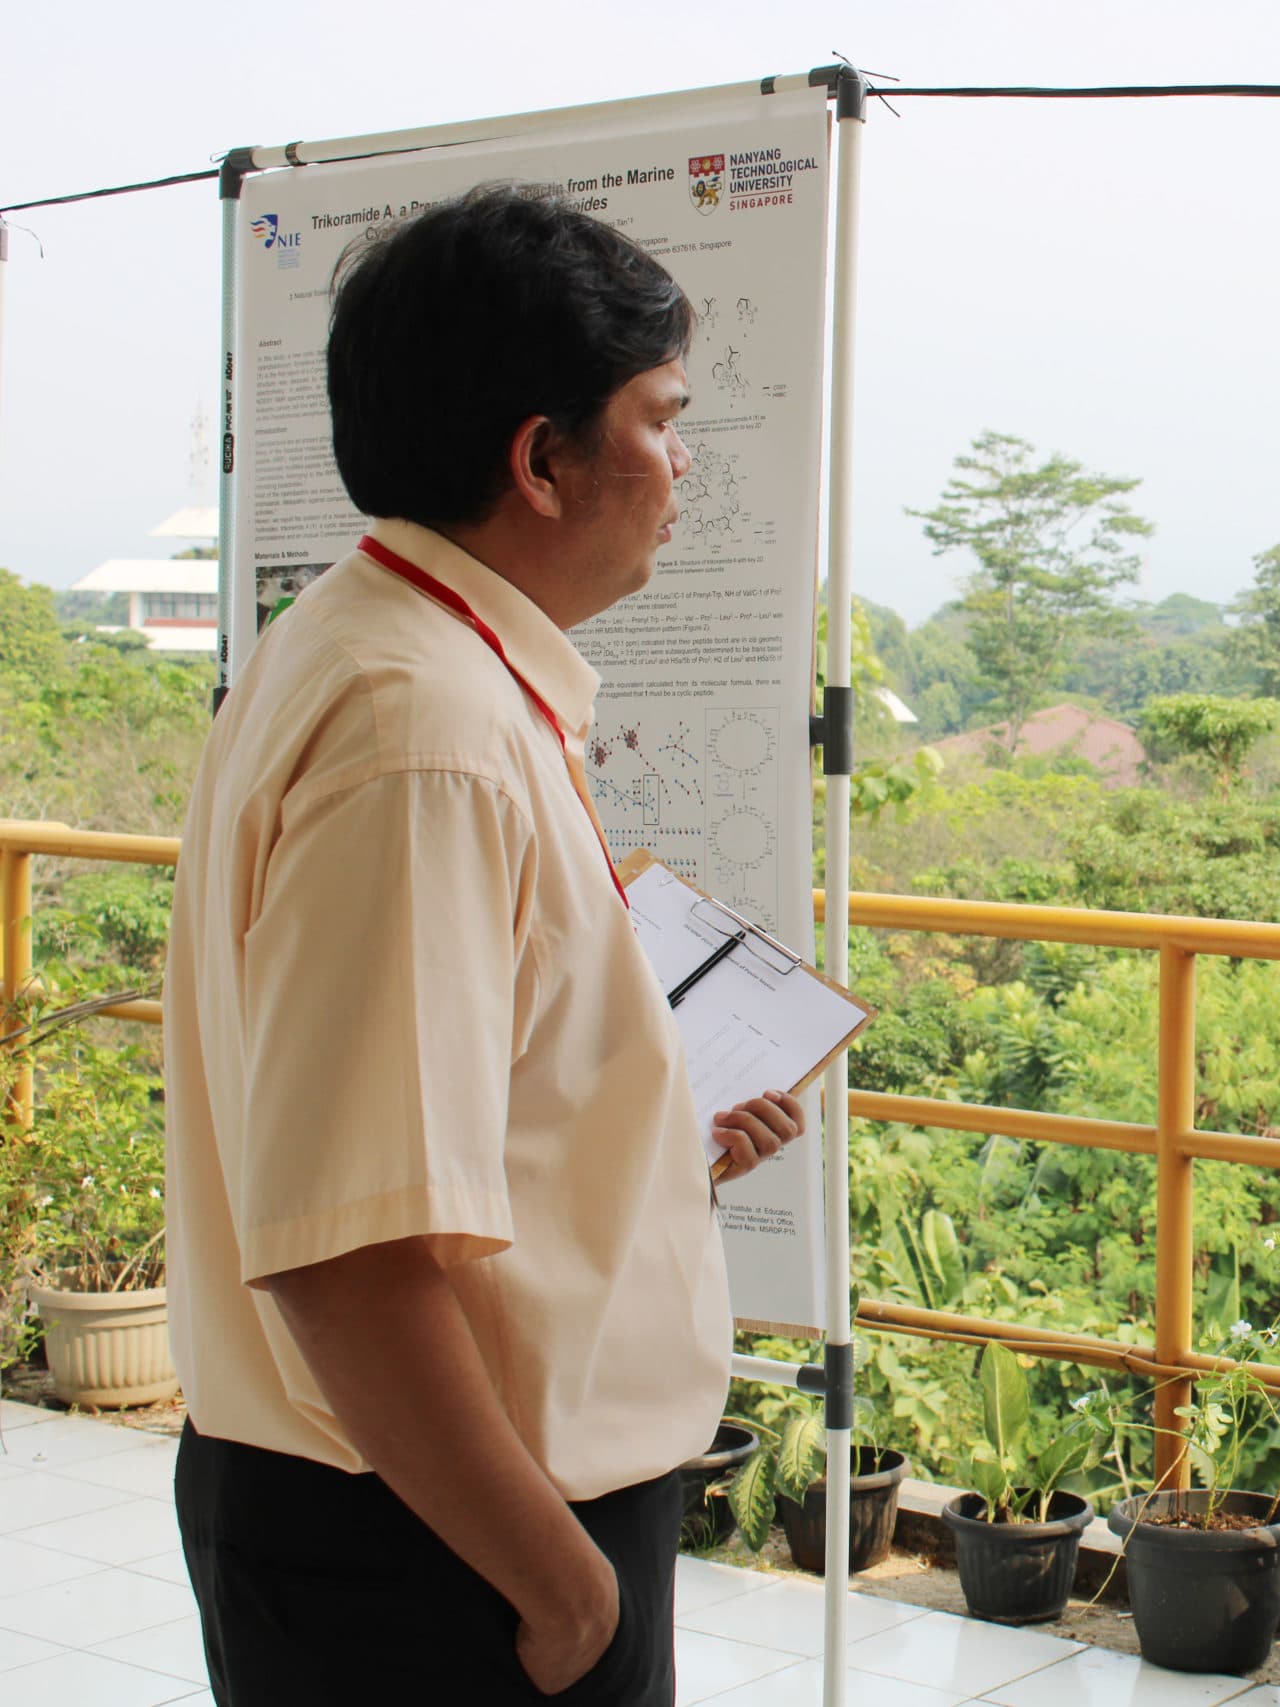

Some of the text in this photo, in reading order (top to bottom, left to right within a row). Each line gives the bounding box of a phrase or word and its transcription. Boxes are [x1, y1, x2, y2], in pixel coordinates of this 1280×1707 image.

[730, 148, 781, 166] NANYANG
[730, 158, 818, 179] TECHNOLOGICAL
[567, 178, 598, 192] from
[602, 174, 623, 189] the
[626, 167, 675, 185] Marine
[730, 175, 793, 193] UNIVERSITY
[730, 194, 793, 210] SINGAPORE
[312, 205, 380, 230] Trikoramide
[278, 233, 302, 247] NIE
